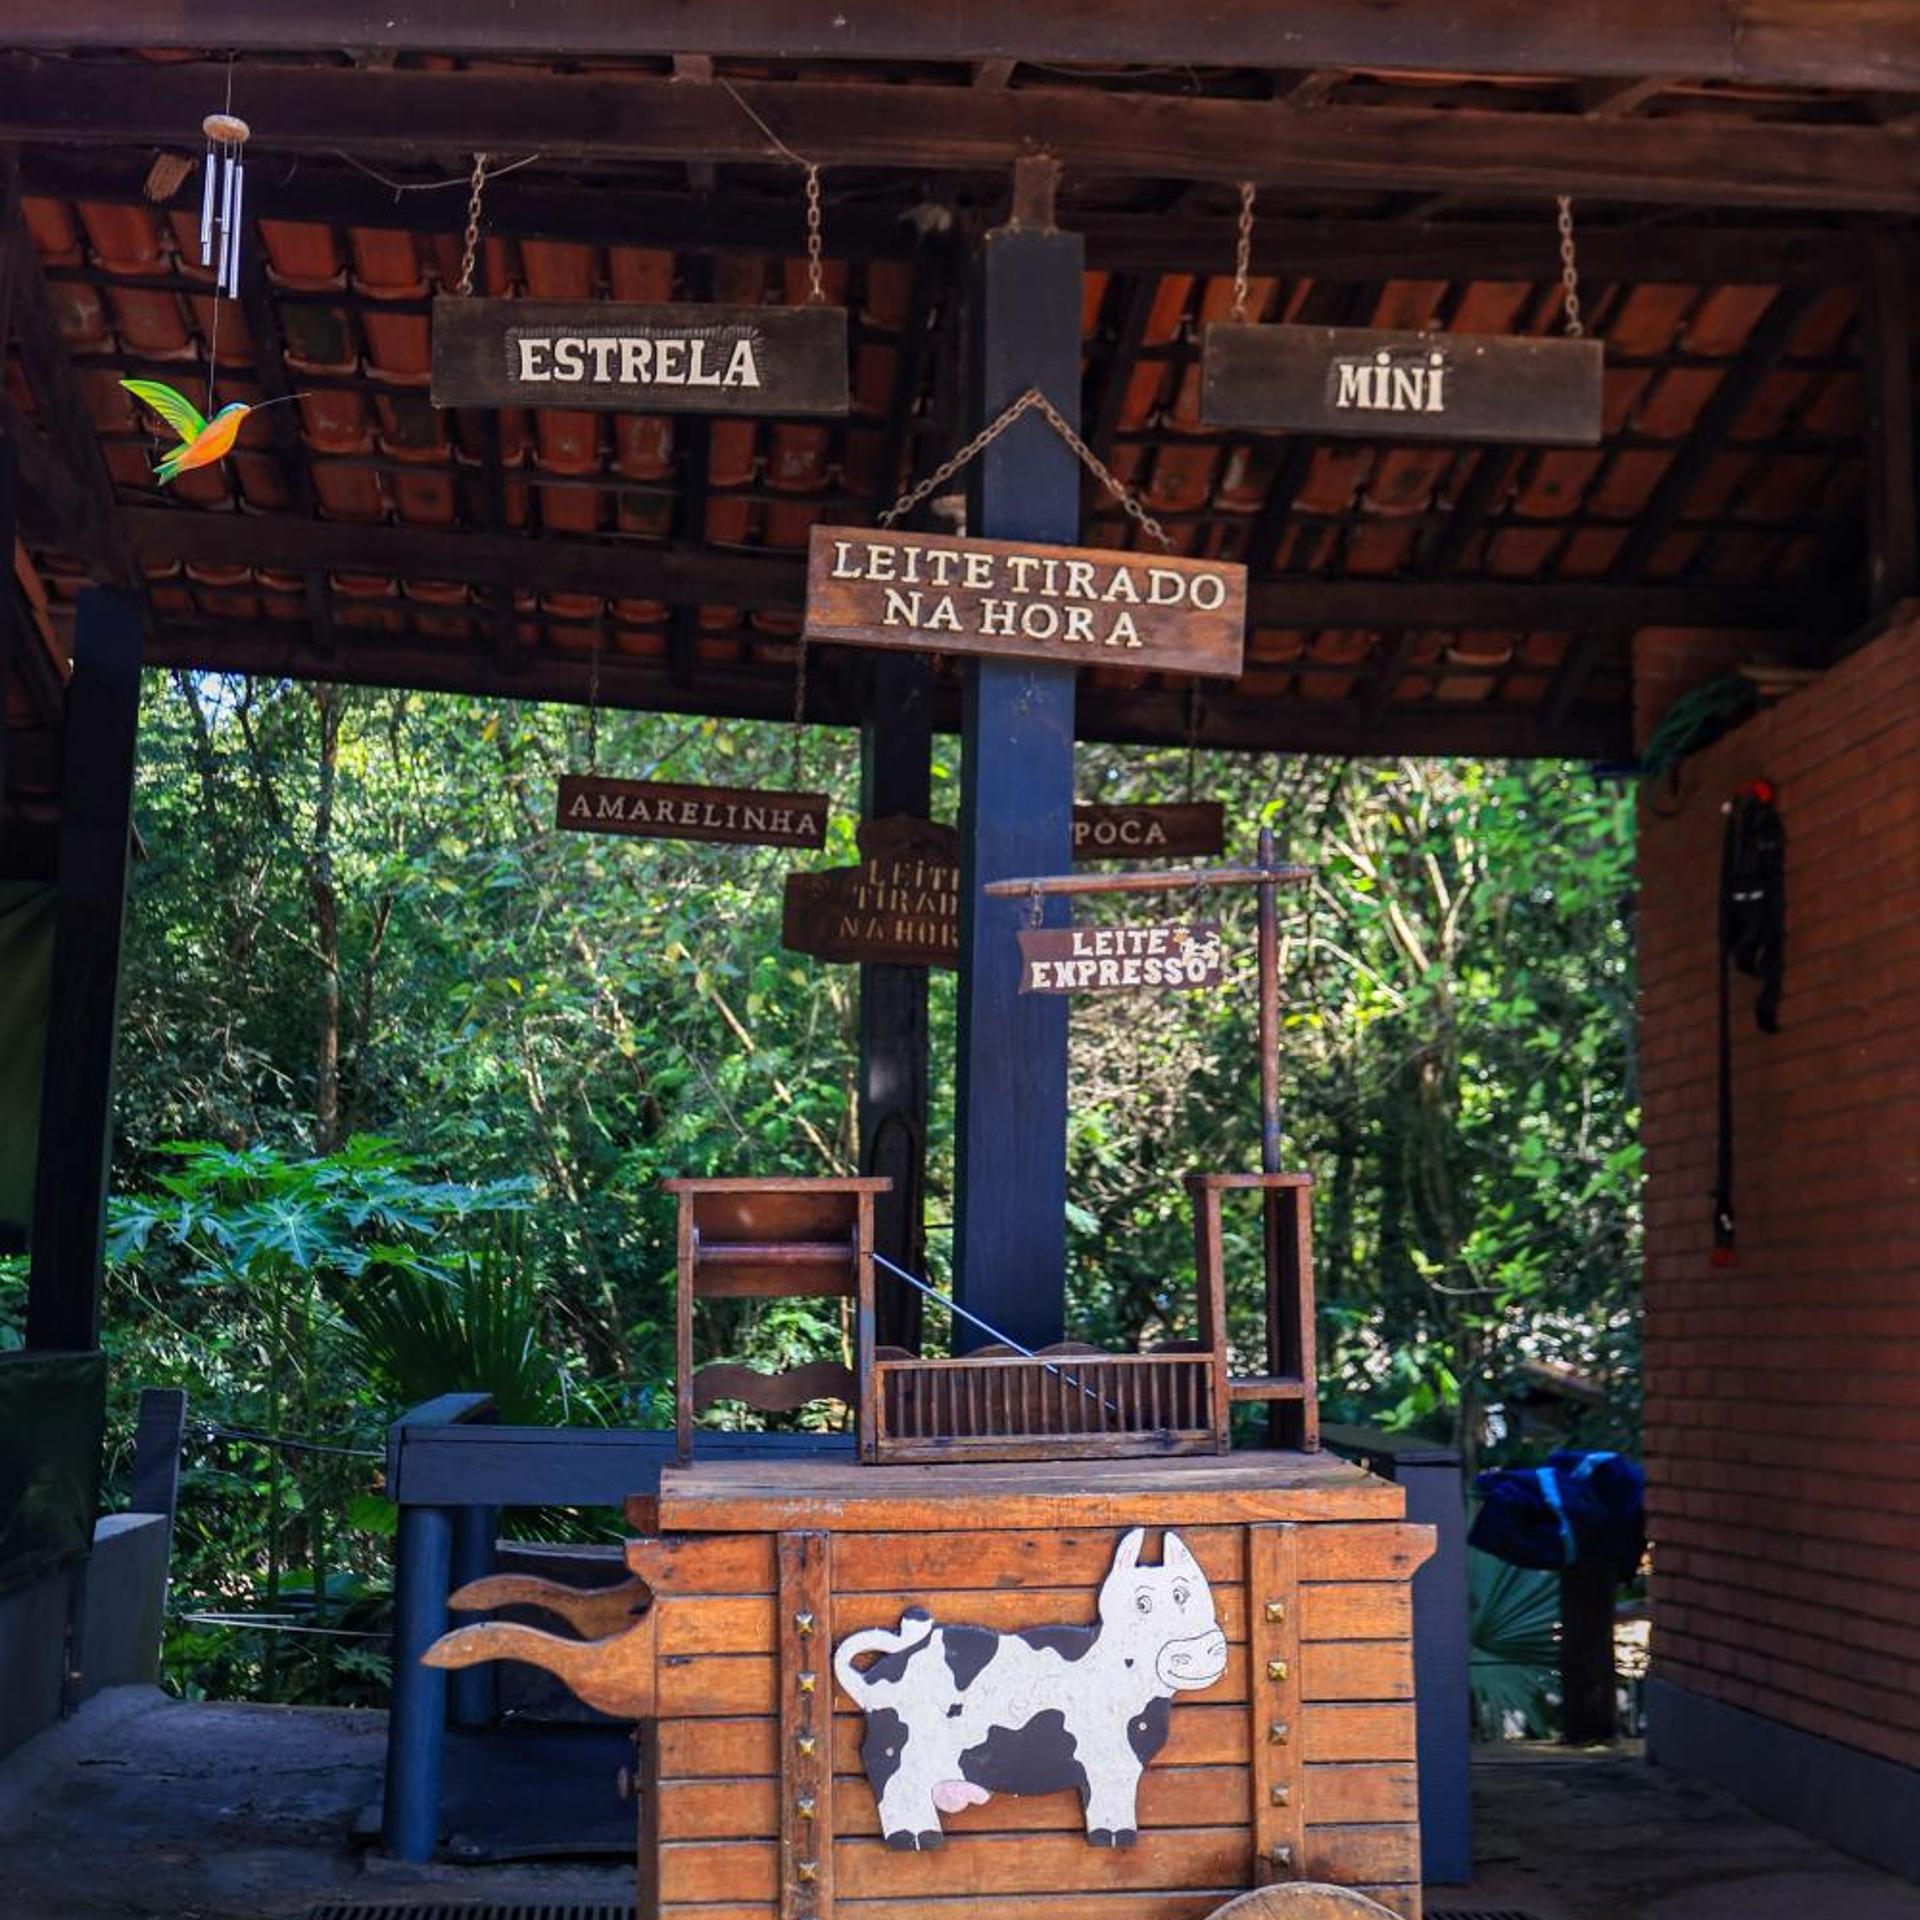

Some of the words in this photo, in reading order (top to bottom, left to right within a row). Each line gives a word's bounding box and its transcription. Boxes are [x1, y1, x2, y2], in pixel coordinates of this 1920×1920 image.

[518, 338, 760, 388] ESTRELA
[831, 541, 994, 590] LEITE
[1006, 555, 1226, 611] TIRADO
[883, 588, 964, 632] NA
[978, 598, 1143, 648] HORA
[568, 794, 818, 835] AMARELINHA
[1072, 820, 1168, 845] POCA
[852, 885, 958, 916] TIRAD
[839, 915, 885, 940] NA
[894, 919, 959, 948] HOR
[1072, 929, 1170, 957] LEITE
[1030, 957, 1207, 989] EXPRESSO
